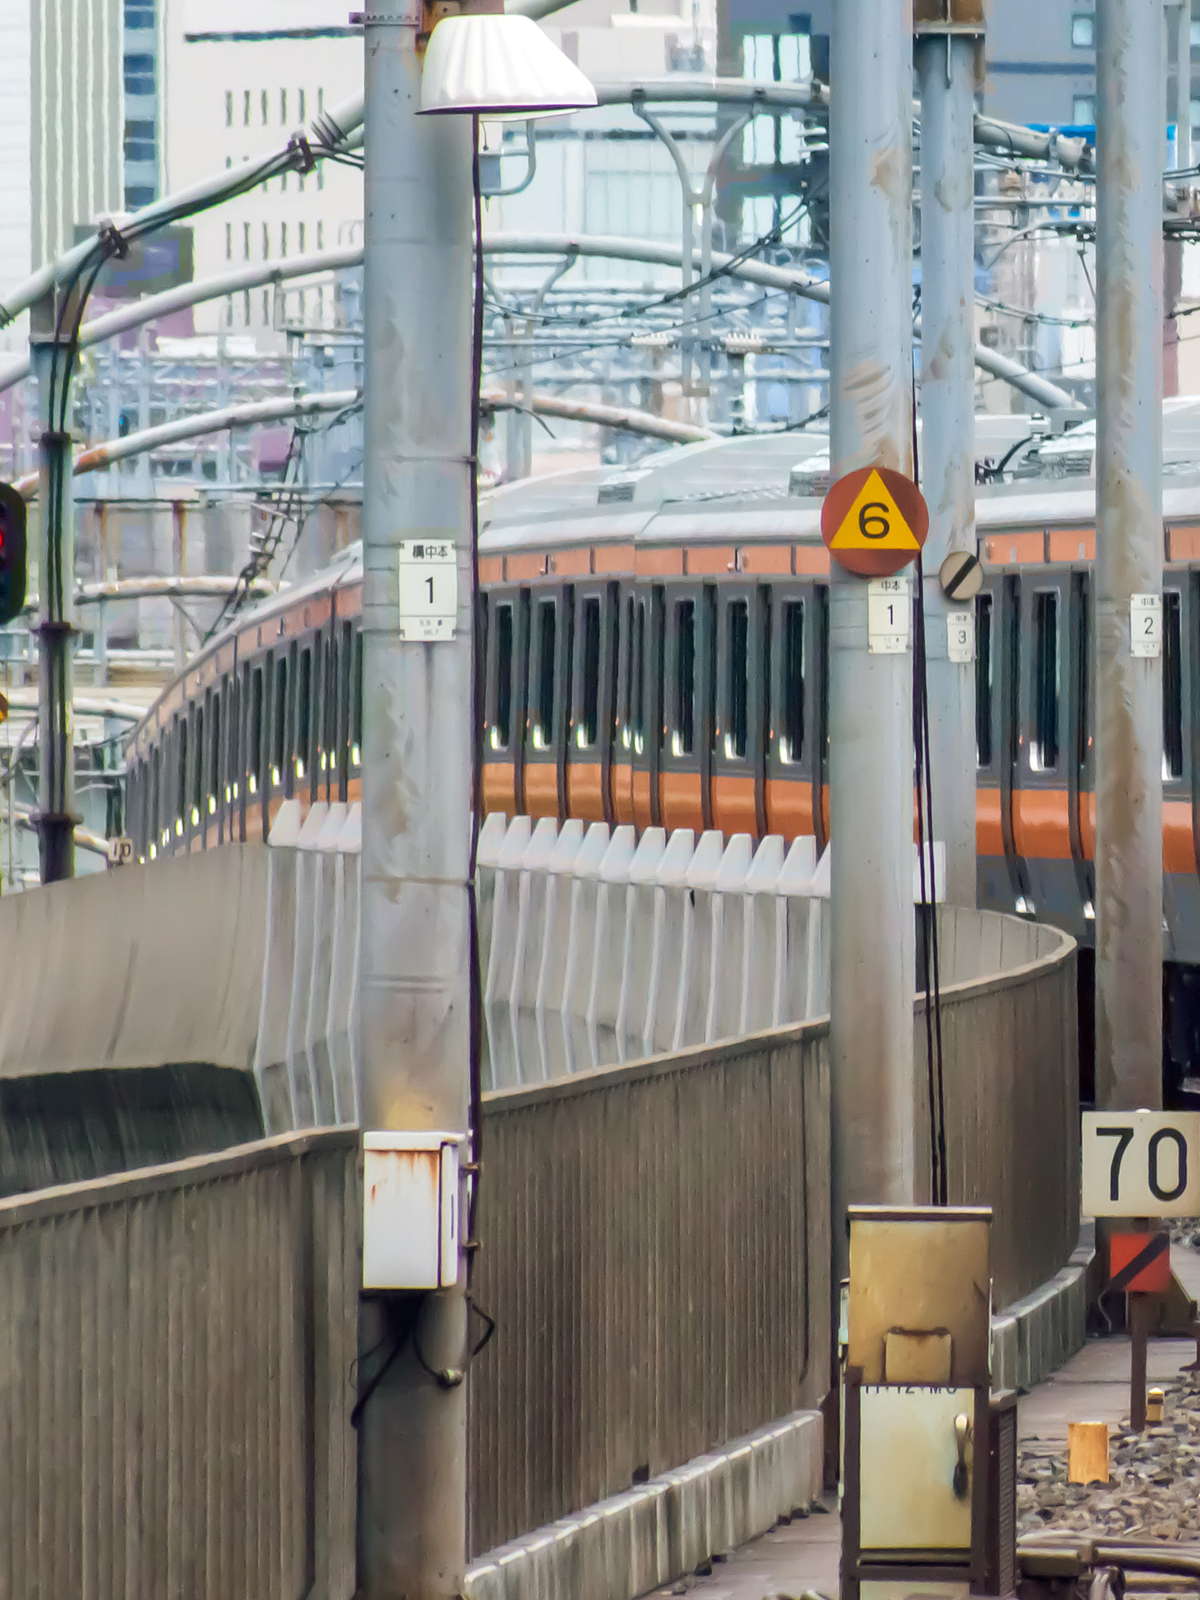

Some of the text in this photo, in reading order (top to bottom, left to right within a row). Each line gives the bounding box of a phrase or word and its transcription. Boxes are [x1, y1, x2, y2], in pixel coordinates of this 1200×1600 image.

[858, 502, 891, 540] 6
[425, 576, 434, 604] 1
[887, 604, 894, 625] 1
[1143, 616, 1154, 635] 2
[958, 630, 967, 644] 3
[1096, 1127, 1188, 1201] 70
